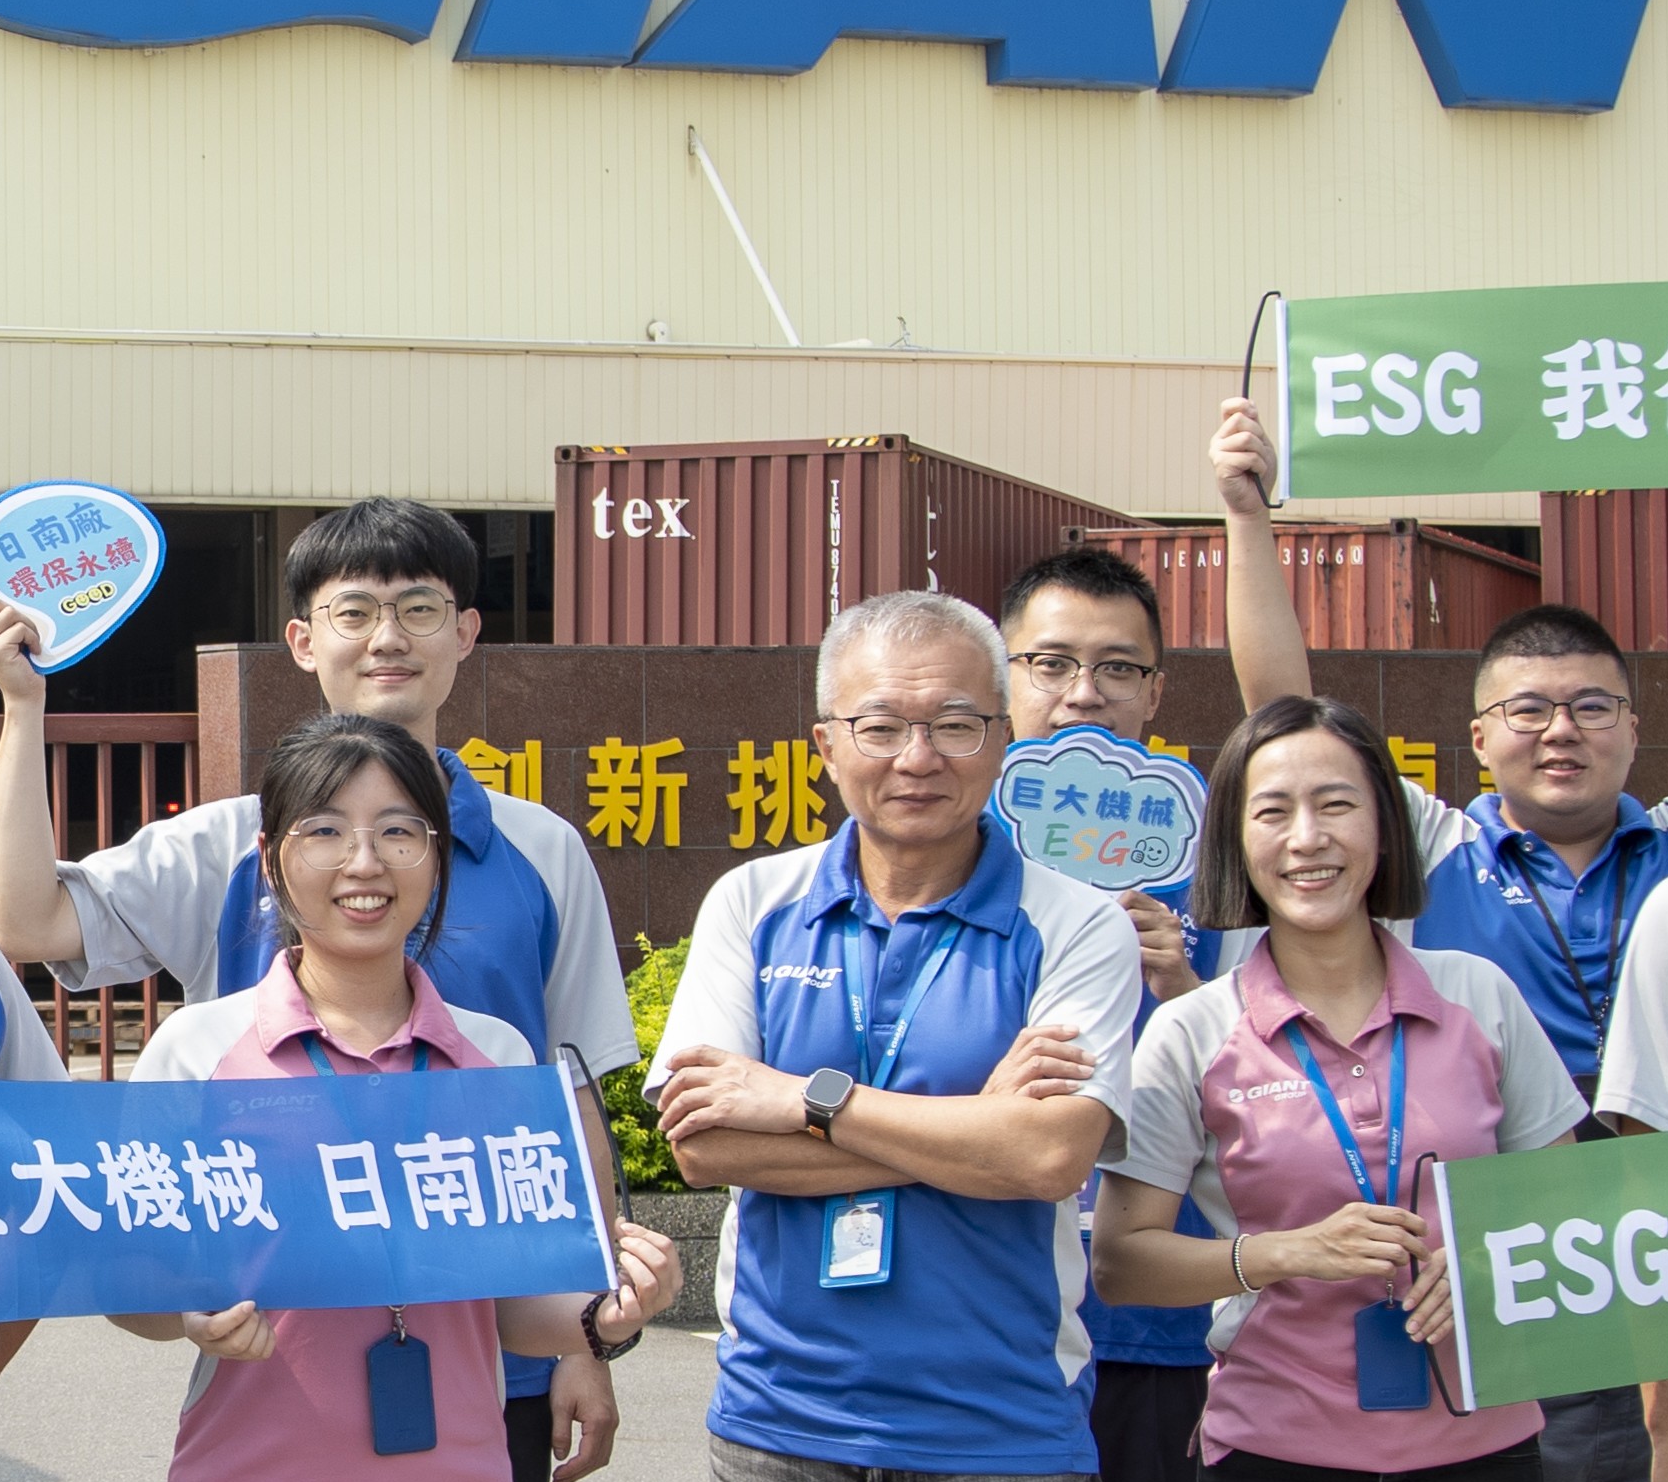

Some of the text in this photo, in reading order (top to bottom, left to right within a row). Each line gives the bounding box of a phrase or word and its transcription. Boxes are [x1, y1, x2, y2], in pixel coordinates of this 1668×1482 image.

[1312, 350, 1482, 438] ESG
[830, 479, 841, 547] TEMU
[6, 536, 141, 599] 環保永續
[1010, 776, 1176, 829] 巨大機械
[1042, 822, 1131, 867] ESG
[1246, 1079, 1311, 1101] GIANT
[316, 1124, 577, 1231] 日南廠
